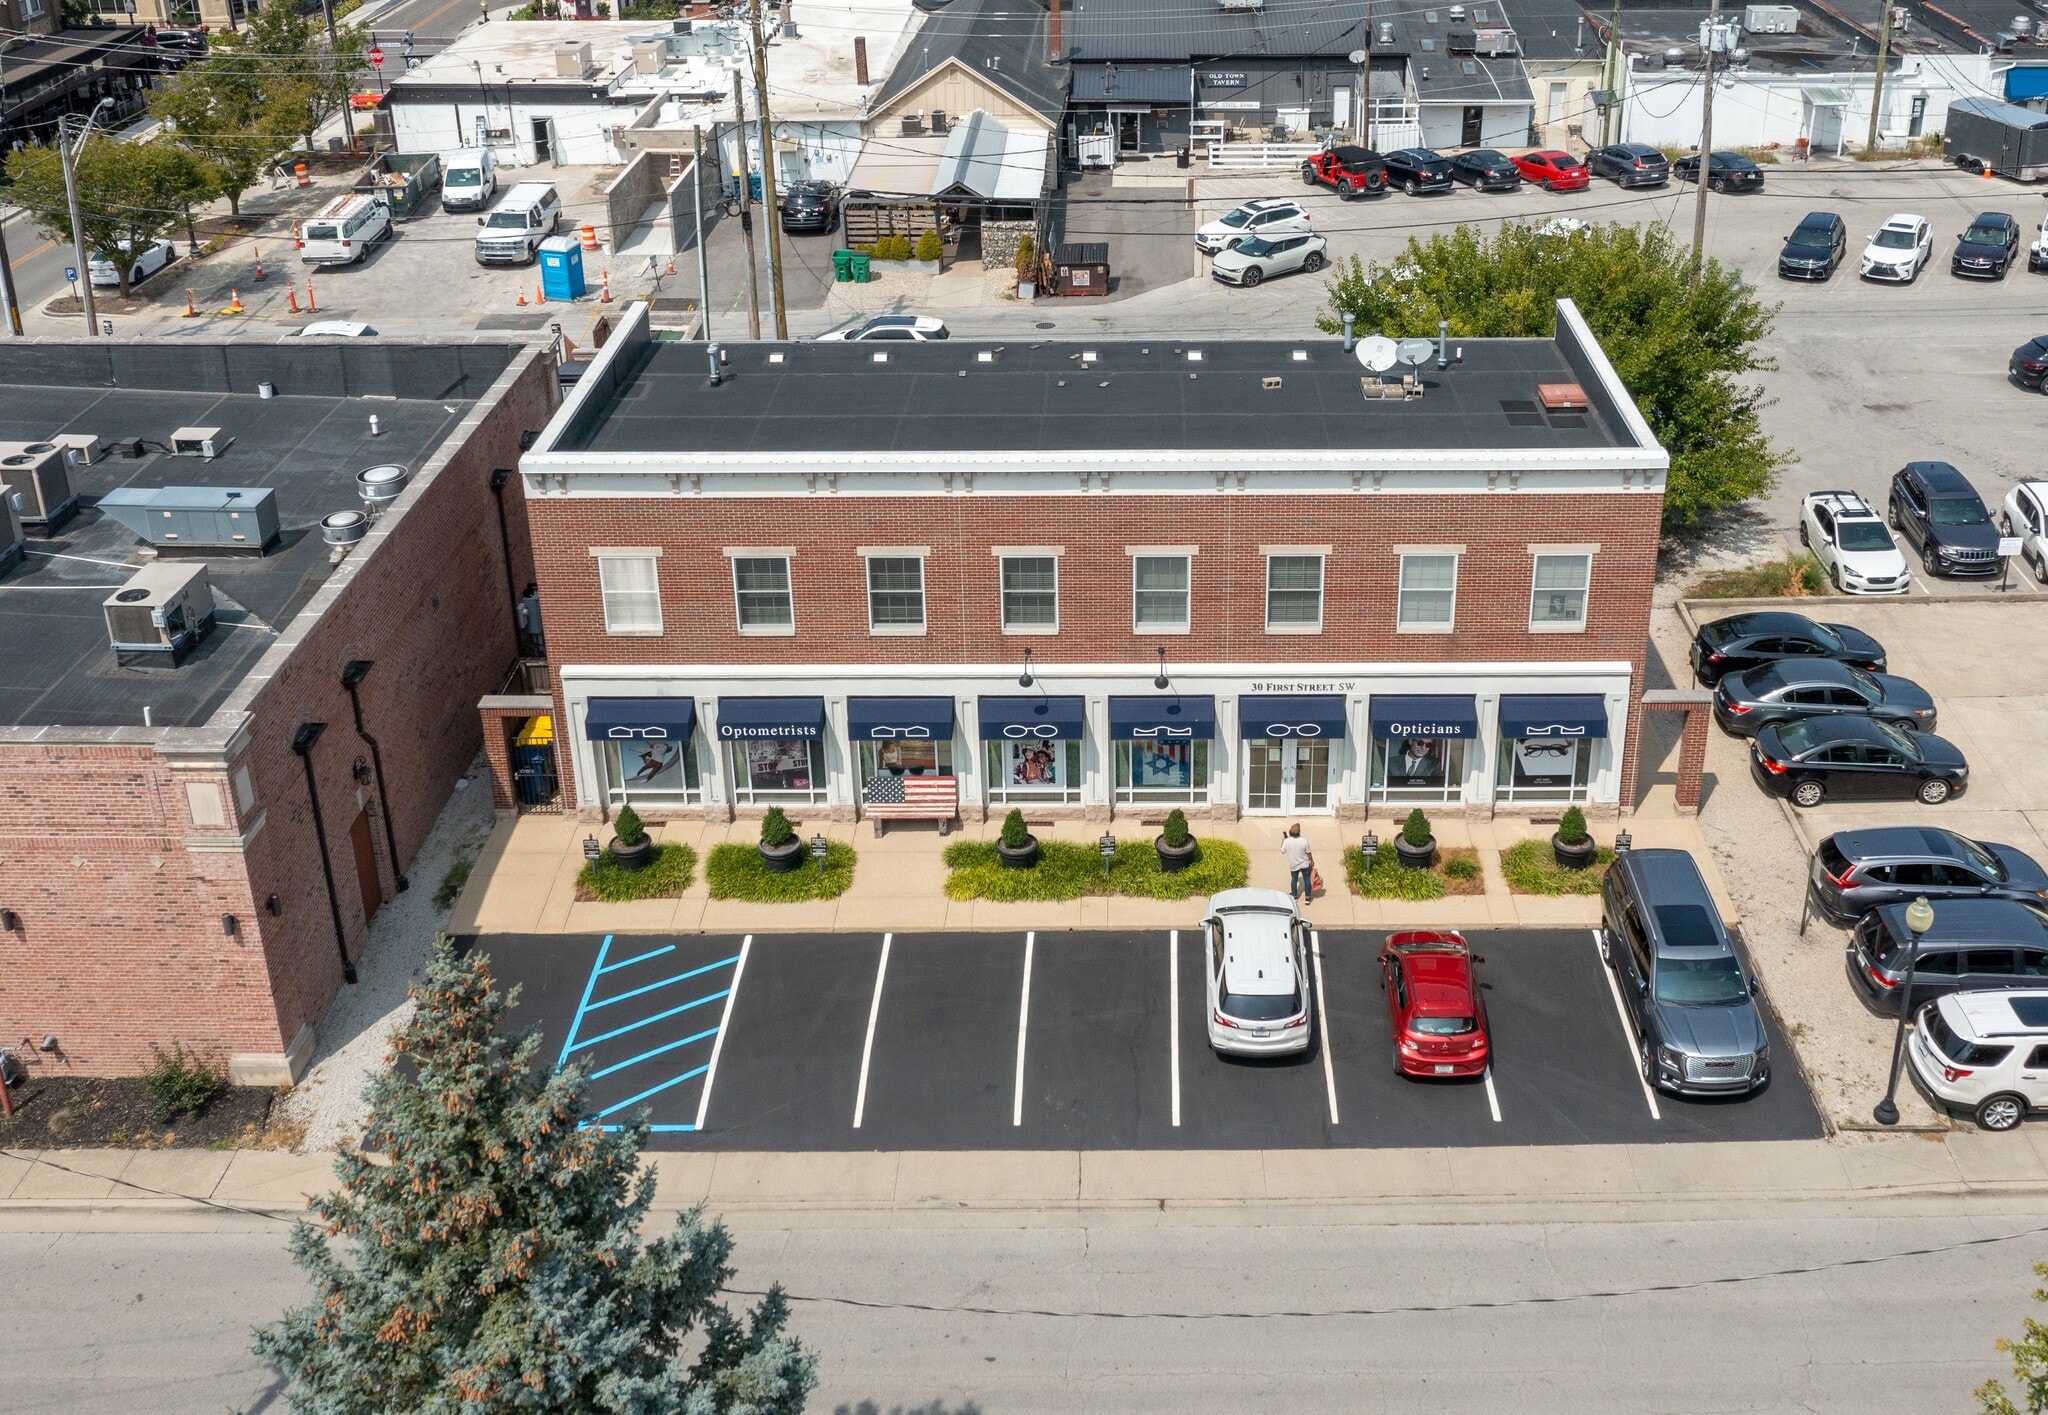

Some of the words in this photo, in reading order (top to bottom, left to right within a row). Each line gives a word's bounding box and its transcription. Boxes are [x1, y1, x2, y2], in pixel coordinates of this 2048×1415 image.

[1251, 683, 1263, 692] 30
[1266, 683, 1294, 692] FIRST
[1297, 683, 1334, 692] STREET
[1338, 682, 1355, 691] SW
[721, 725, 816, 739] Optometrists
[1390, 723, 1461, 737] Opticians
[758, 762, 778, 771] STOP
